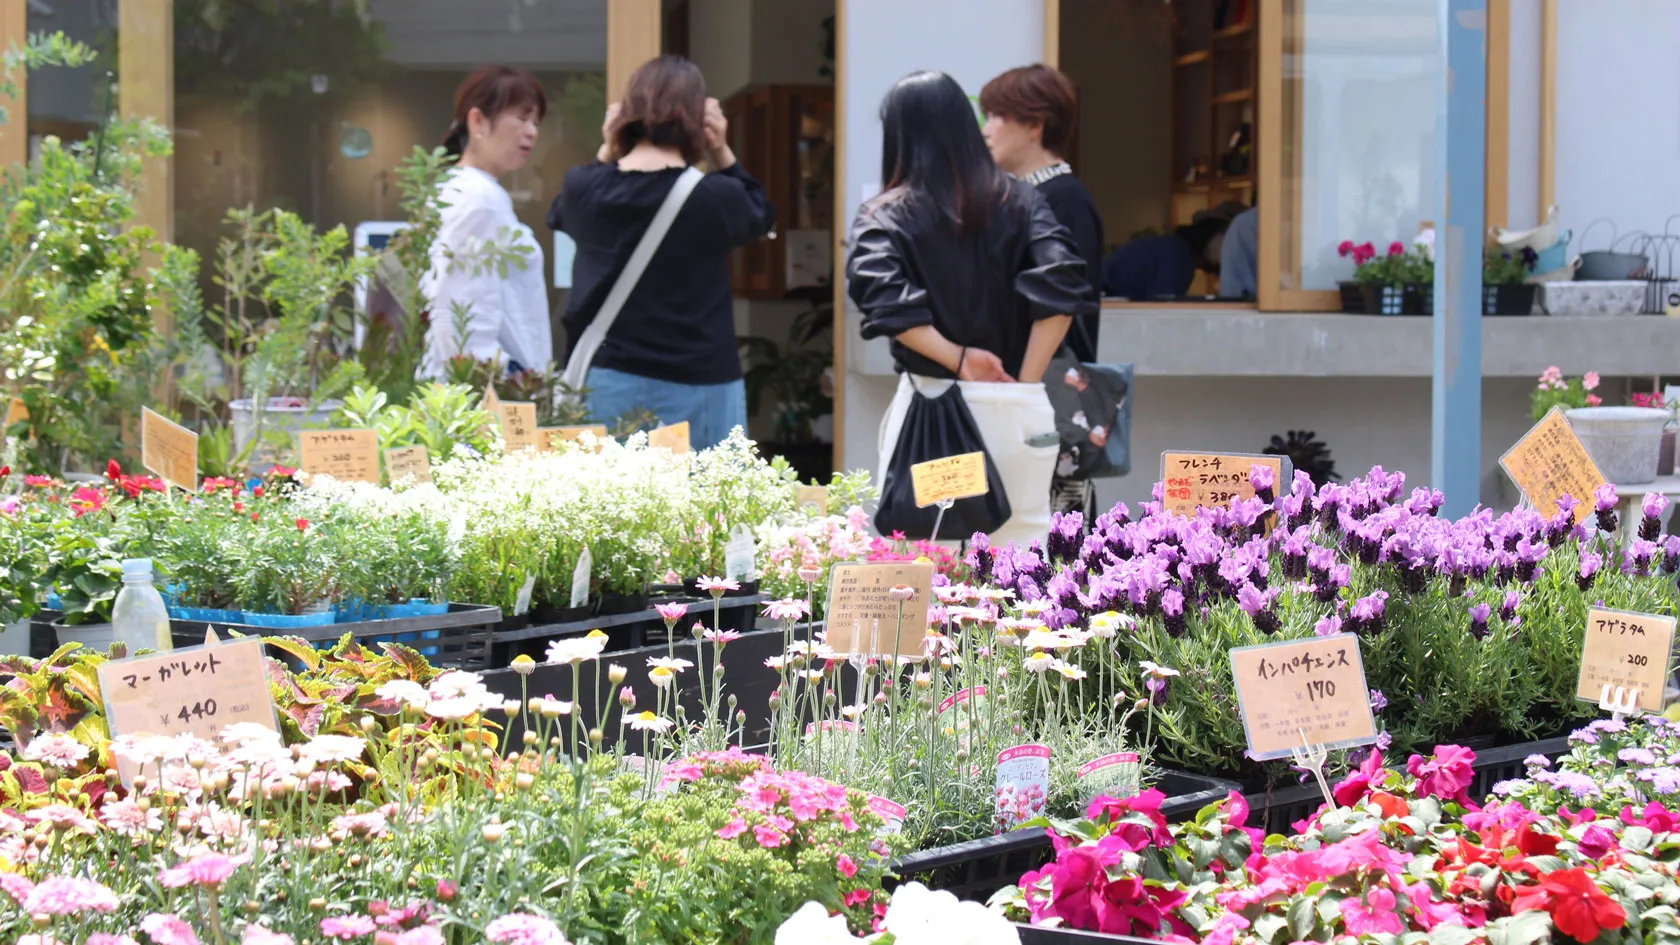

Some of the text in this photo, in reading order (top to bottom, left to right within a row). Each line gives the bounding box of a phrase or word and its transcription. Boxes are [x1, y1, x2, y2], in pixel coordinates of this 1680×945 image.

[1179, 457, 1222, 470] フレンチ
[1596, 619, 1646, 636] アゲラタム
[122, 653, 222, 689] マーガレット
[1258, 649, 1350, 680] インパチェンス
[1627, 654, 1649, 667] 200
[1306, 680, 1336, 701] 170
[178, 698, 217, 723] 440
